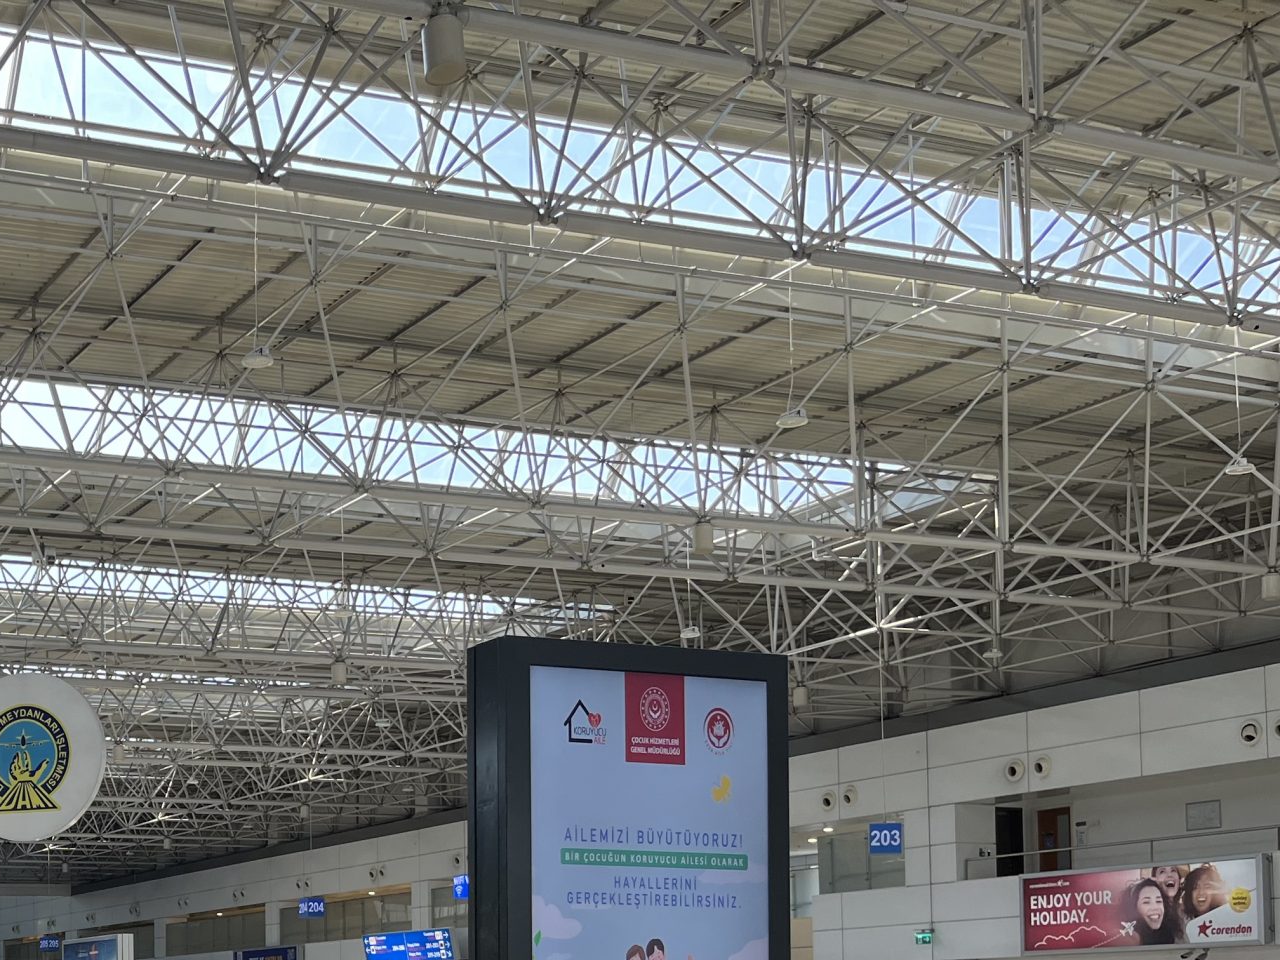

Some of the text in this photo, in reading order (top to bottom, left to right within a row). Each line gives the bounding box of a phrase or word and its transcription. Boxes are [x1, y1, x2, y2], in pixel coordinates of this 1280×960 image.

[0, 708, 60, 733] MEYDANLARI
[573, 726, 607, 737] KORUYUCU
[631, 736, 649, 746] ÇOCUK
[630, 746, 647, 755] GENEL
[564, 824, 743, 848] AİLEMİZİ BÜYÜTÜYORUZ!
[870, 829, 901, 848] 203
[564, 851, 744, 867] BİR ÇOCUĞUN KORUYUCU AİLESİ OLARAK
[613, 875, 697, 891] HAYALLERİNİ
[308, 902, 325, 913] 204
[566, 891, 742, 909] GERÇEKLEŞTİREBİLİRSİNİZ.
[1030, 890, 1112, 910] ENJOY YOUR
[1030, 909, 1089, 926] HOLIDAY.
[1211, 924, 1253, 935] corendon
